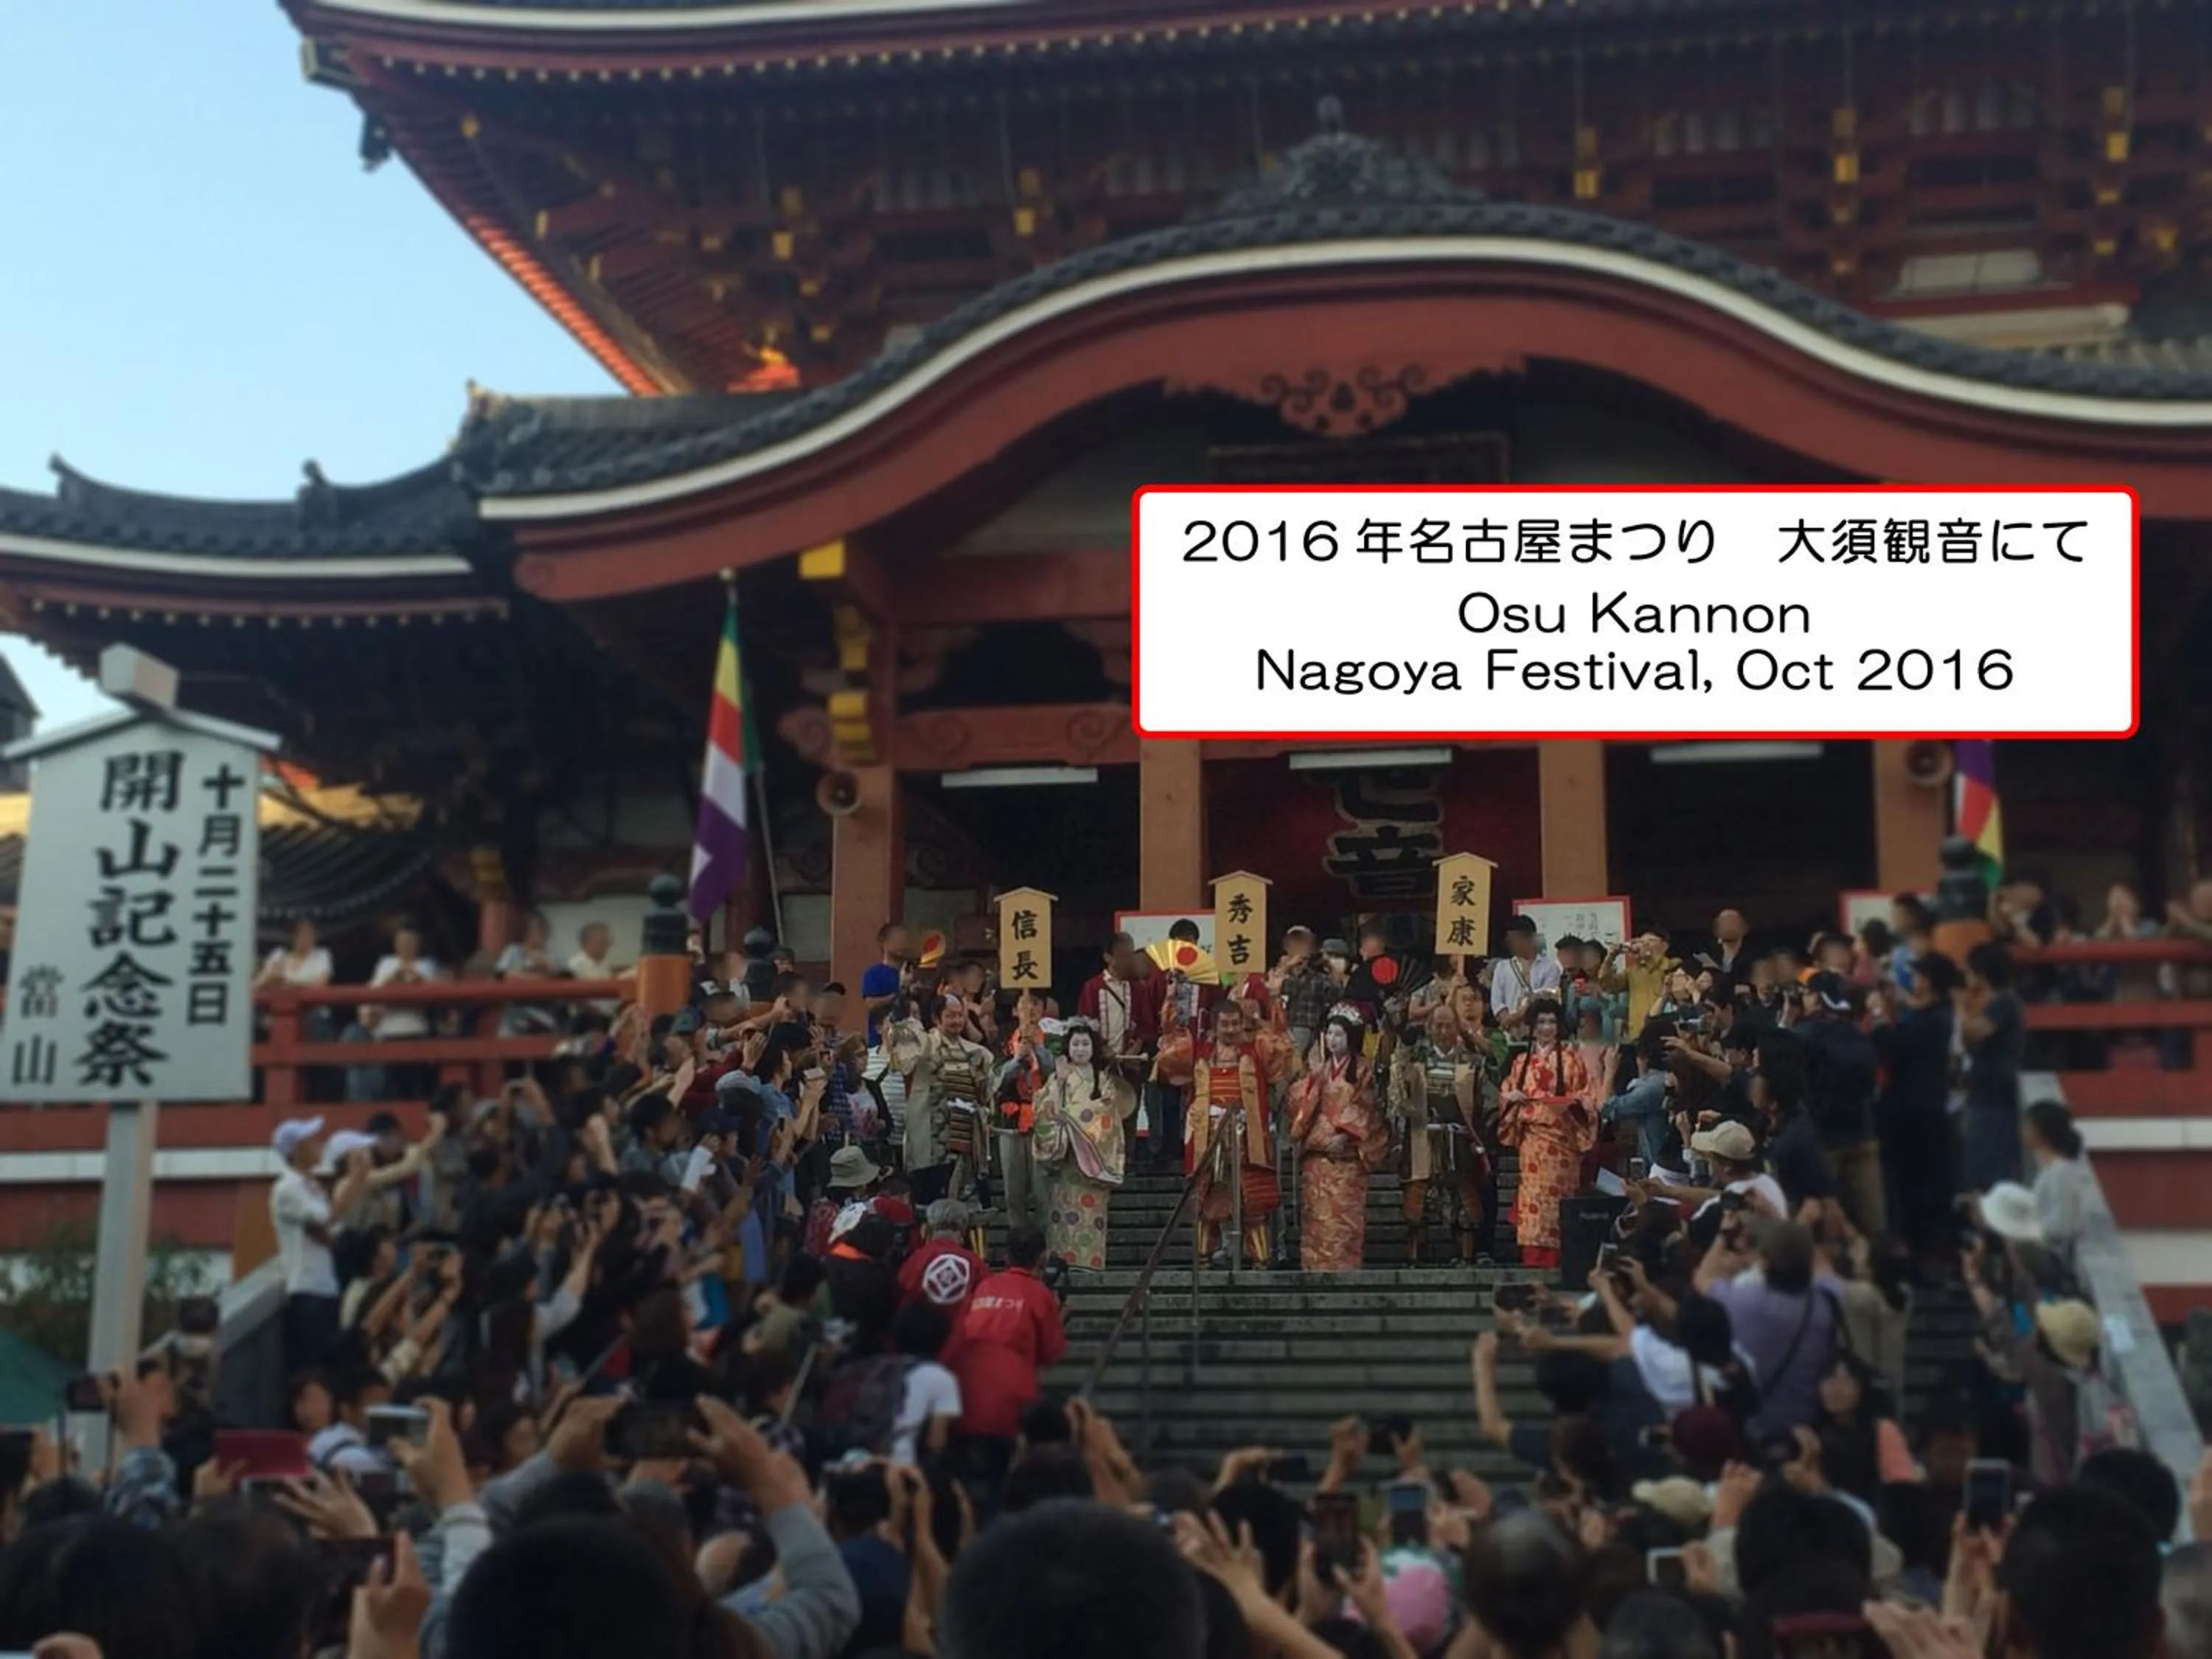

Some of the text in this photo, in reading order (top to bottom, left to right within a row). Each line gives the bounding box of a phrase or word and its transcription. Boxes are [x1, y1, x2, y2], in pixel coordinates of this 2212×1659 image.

[74, 751, 185, 1087] 開山記念祭
[187, 763, 246, 1026] 十月二十五日
[1227, 893, 1253, 965] 秀吉
[1447, 875, 1476, 947] 家康
[1012, 909, 1038, 981] 信長
